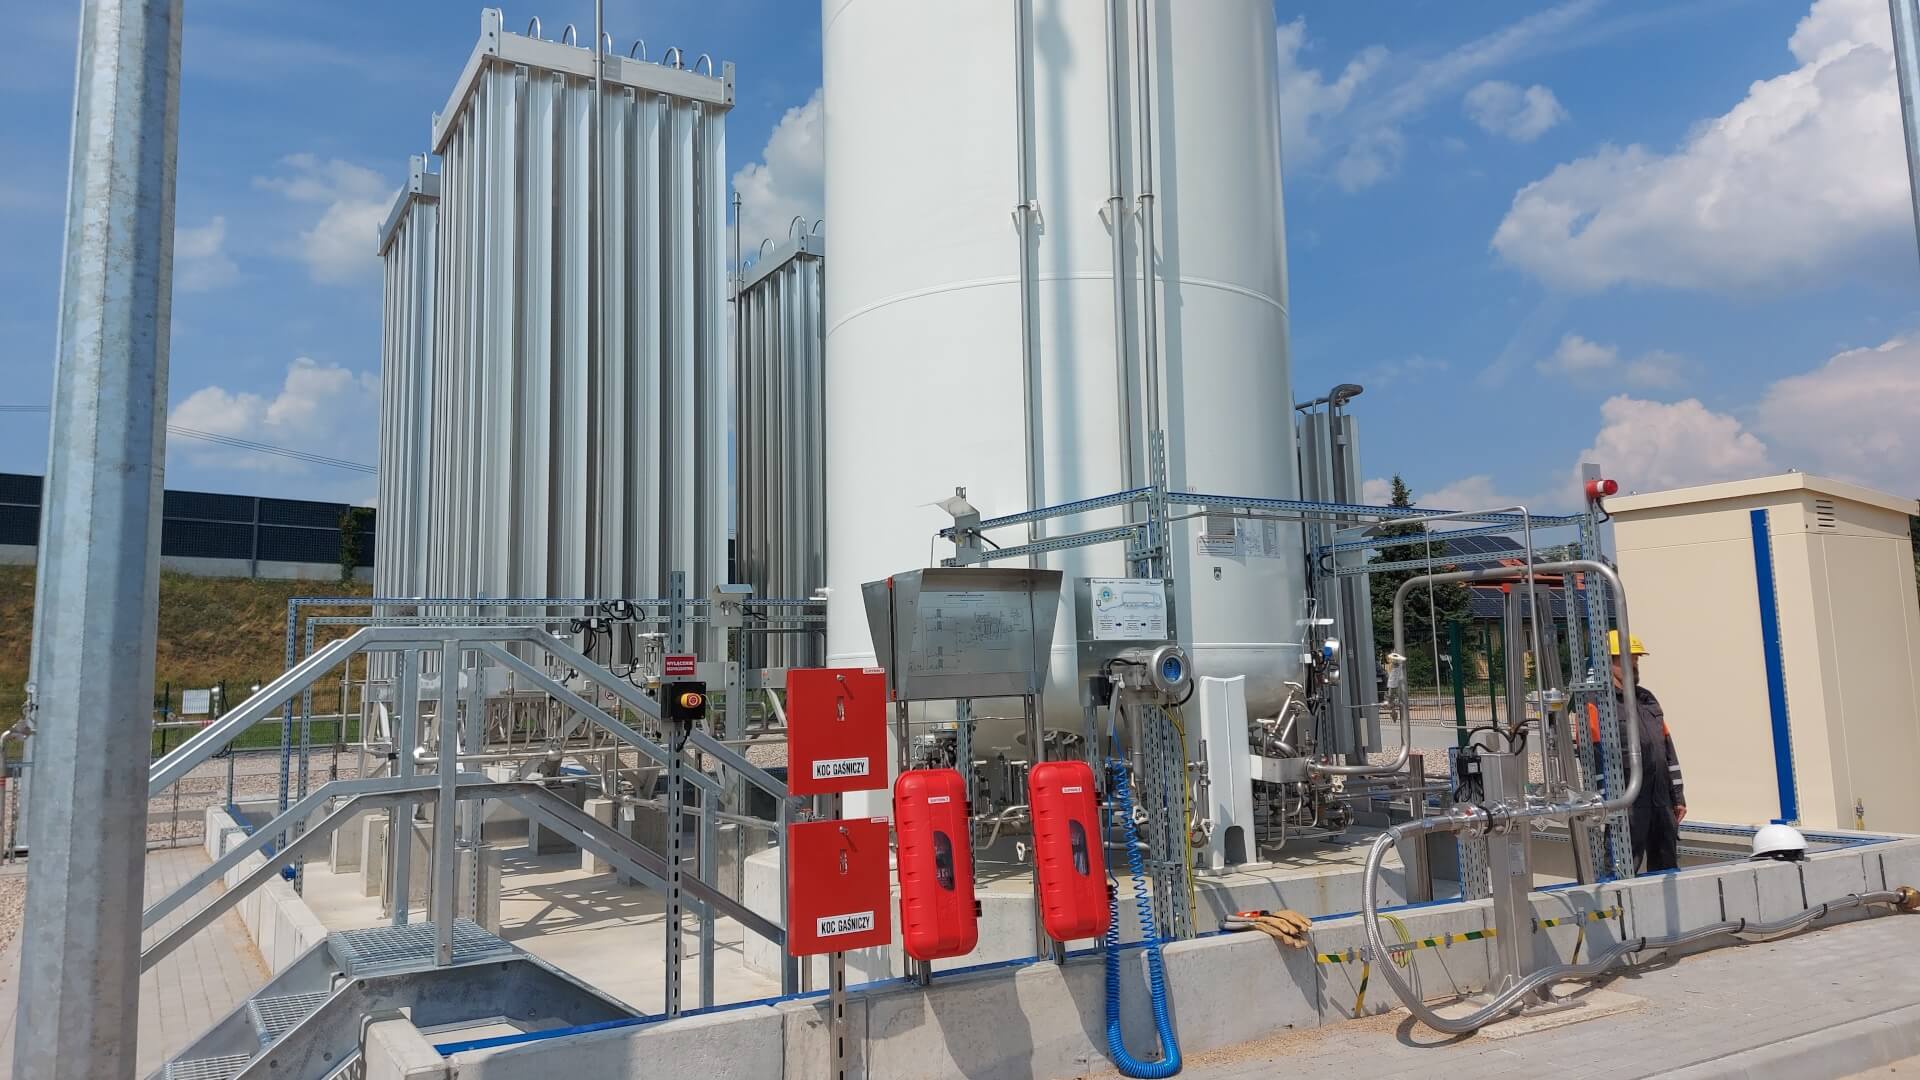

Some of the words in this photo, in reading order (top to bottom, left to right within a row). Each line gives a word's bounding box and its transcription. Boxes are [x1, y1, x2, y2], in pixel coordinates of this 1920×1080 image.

[816, 764, 831, 777] KOC
[833, 761, 865, 776] GAŚNICZY
[821, 920, 836, 935] KOC
[838, 916, 870, 932] GAŚNICZY
